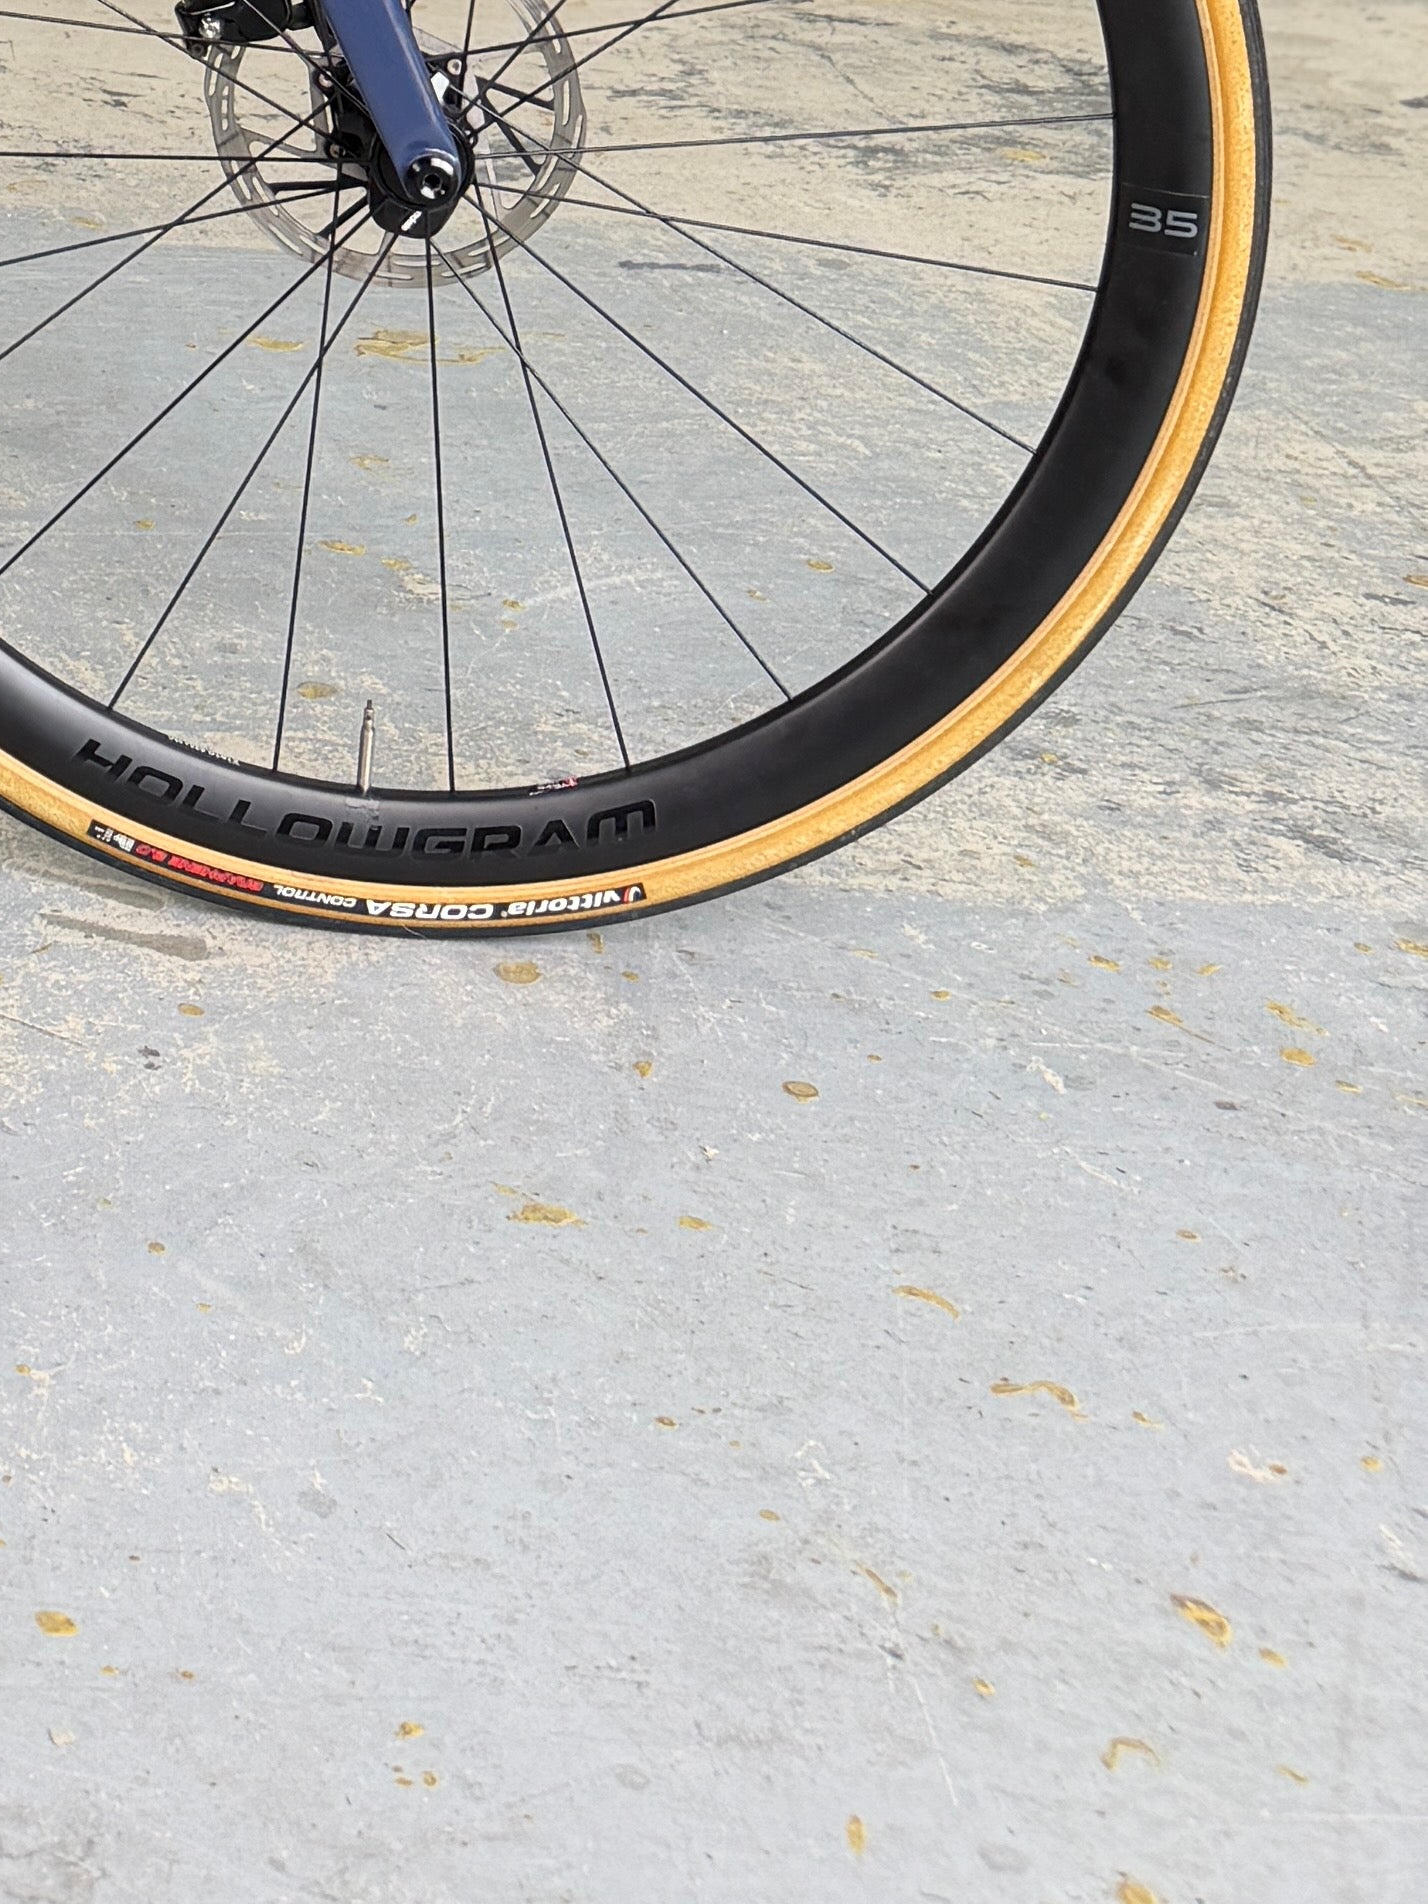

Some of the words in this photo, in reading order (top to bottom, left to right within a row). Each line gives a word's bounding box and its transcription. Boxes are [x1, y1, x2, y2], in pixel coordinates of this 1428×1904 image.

[1128, 202, 1198, 238] 35
[74, 738, 658, 863] HOLLOWGRAM
[274, 883, 357, 909] CONTROL
[366, 899, 495, 921] CORSA
